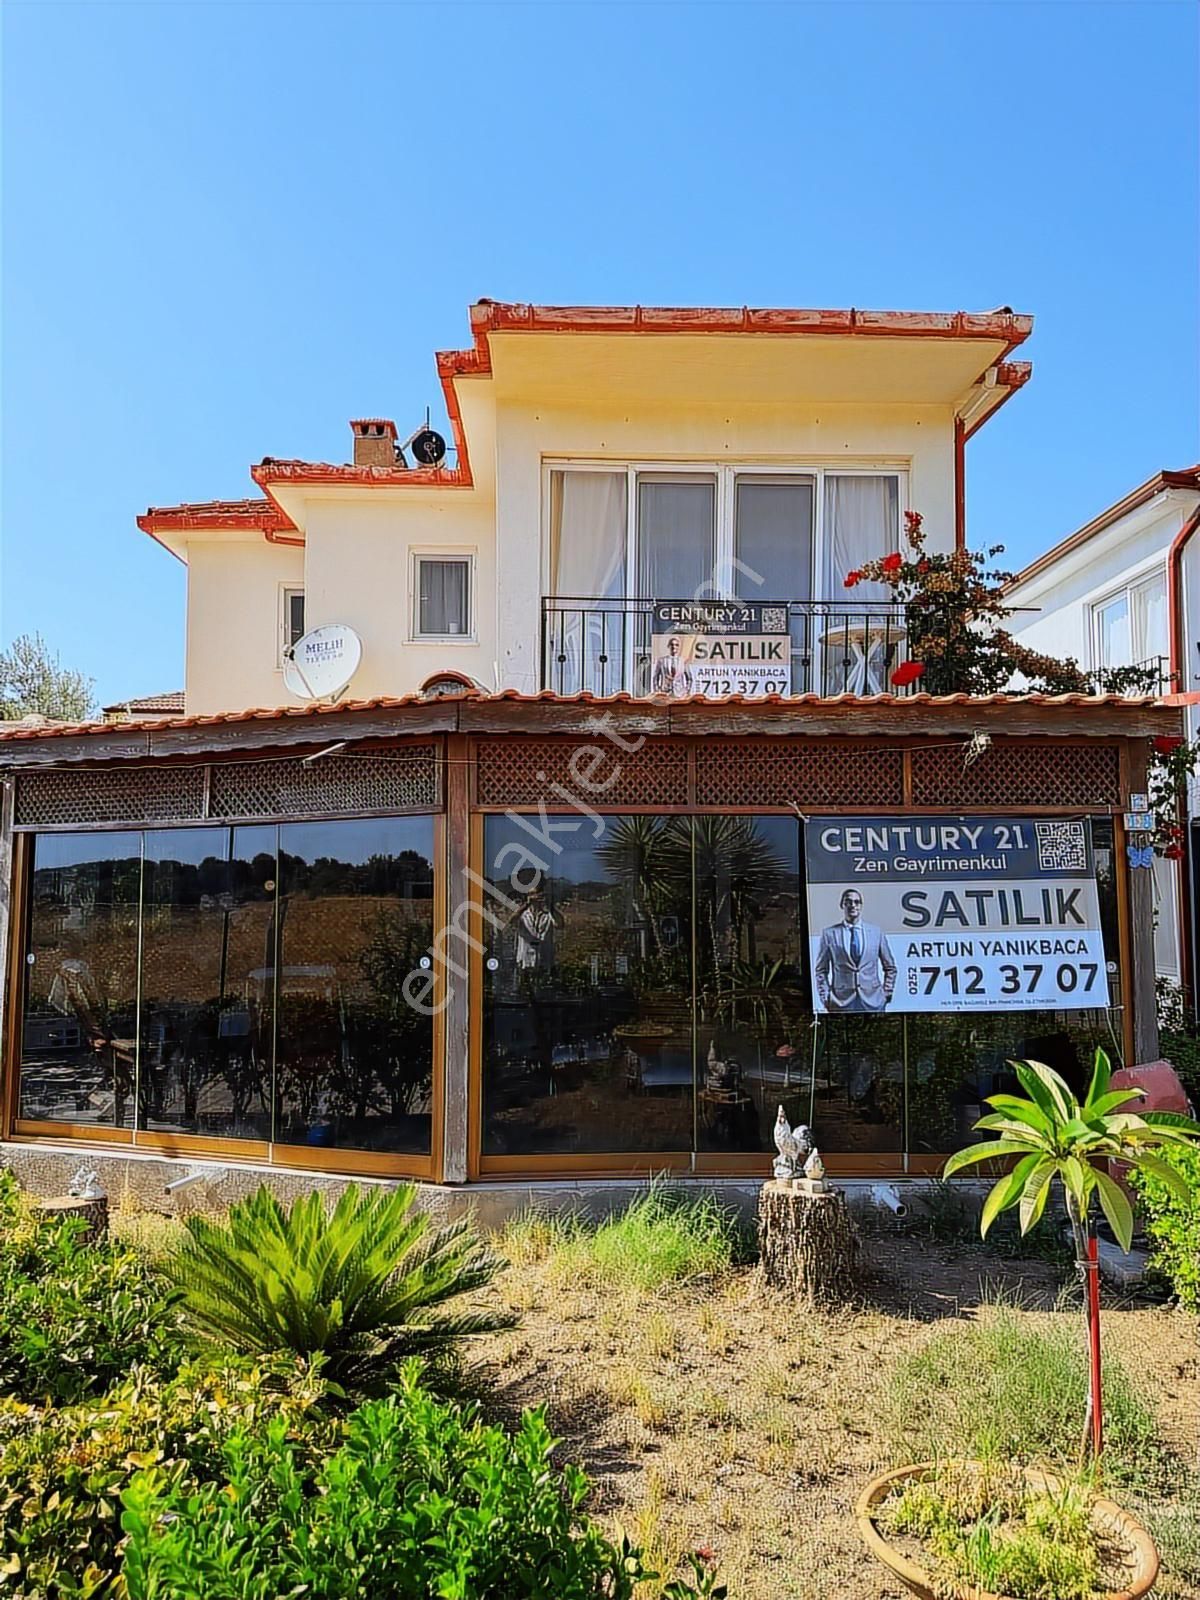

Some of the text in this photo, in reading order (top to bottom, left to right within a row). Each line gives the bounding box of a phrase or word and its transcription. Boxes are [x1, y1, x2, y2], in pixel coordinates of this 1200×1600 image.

[659, 607, 737, 621] CENTURY
[694, 641, 783, 660] SATILIK
[697, 668, 786, 677] ARTUN YANIKBACA
[701, 680, 731, 695] 712
[738, 680, 759, 695] 37
[765, 680, 788, 694] 07
[820, 825, 985, 852] CENTURY
[853, 854, 1007, 874] Zen Gayrimenkul
[901, 887, 1085, 928] SATILIK
[907, 939, 1089, 958] ARTUN YANIKBACA
[908, 966, 919, 996] 0252
[920, 963, 1099, 996] 712 37 07
